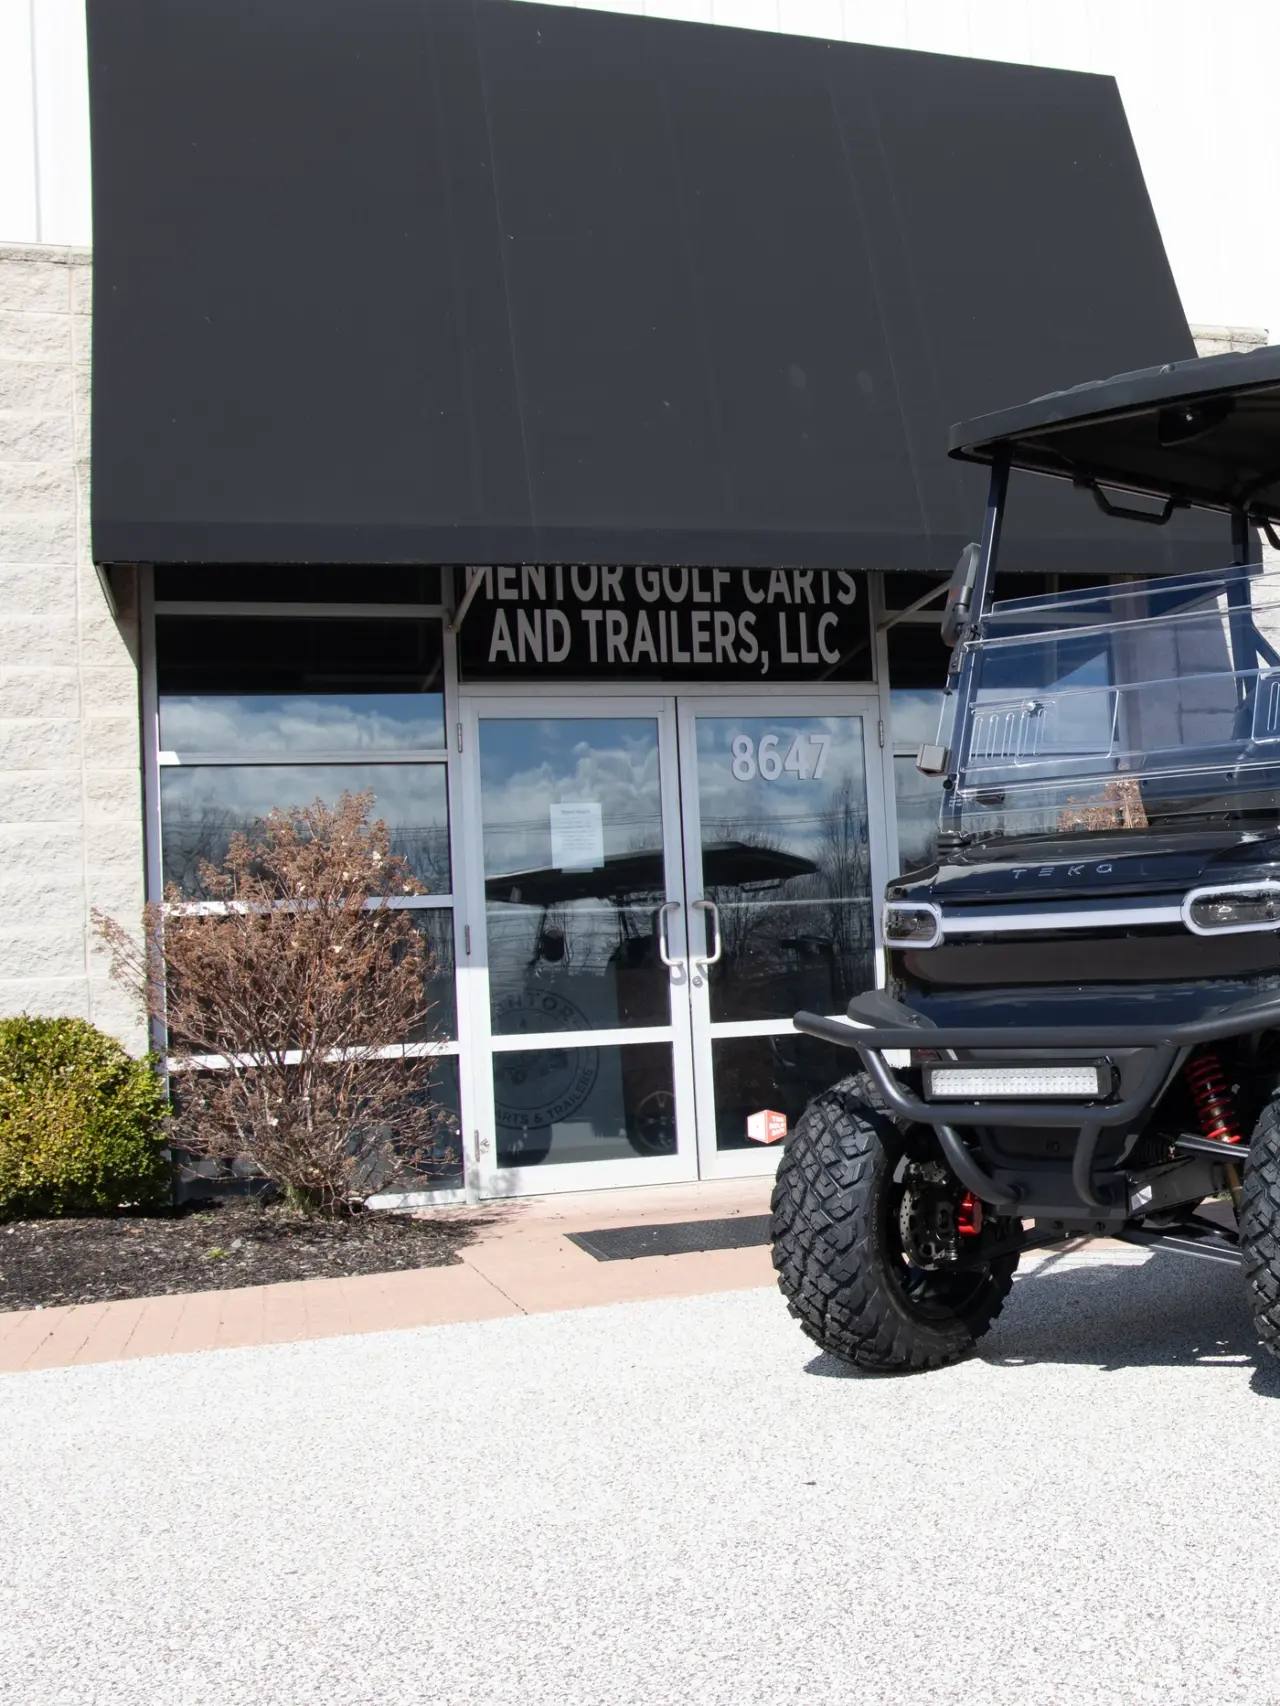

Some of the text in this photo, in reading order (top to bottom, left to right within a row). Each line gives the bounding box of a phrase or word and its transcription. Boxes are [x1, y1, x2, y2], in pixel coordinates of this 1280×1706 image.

[635, 567, 731, 603] GOLF
[742, 569, 857, 605] CARTS
[488, 608, 841, 675] AND TRAILERS, LLC
[731, 734, 831, 782] 8647
